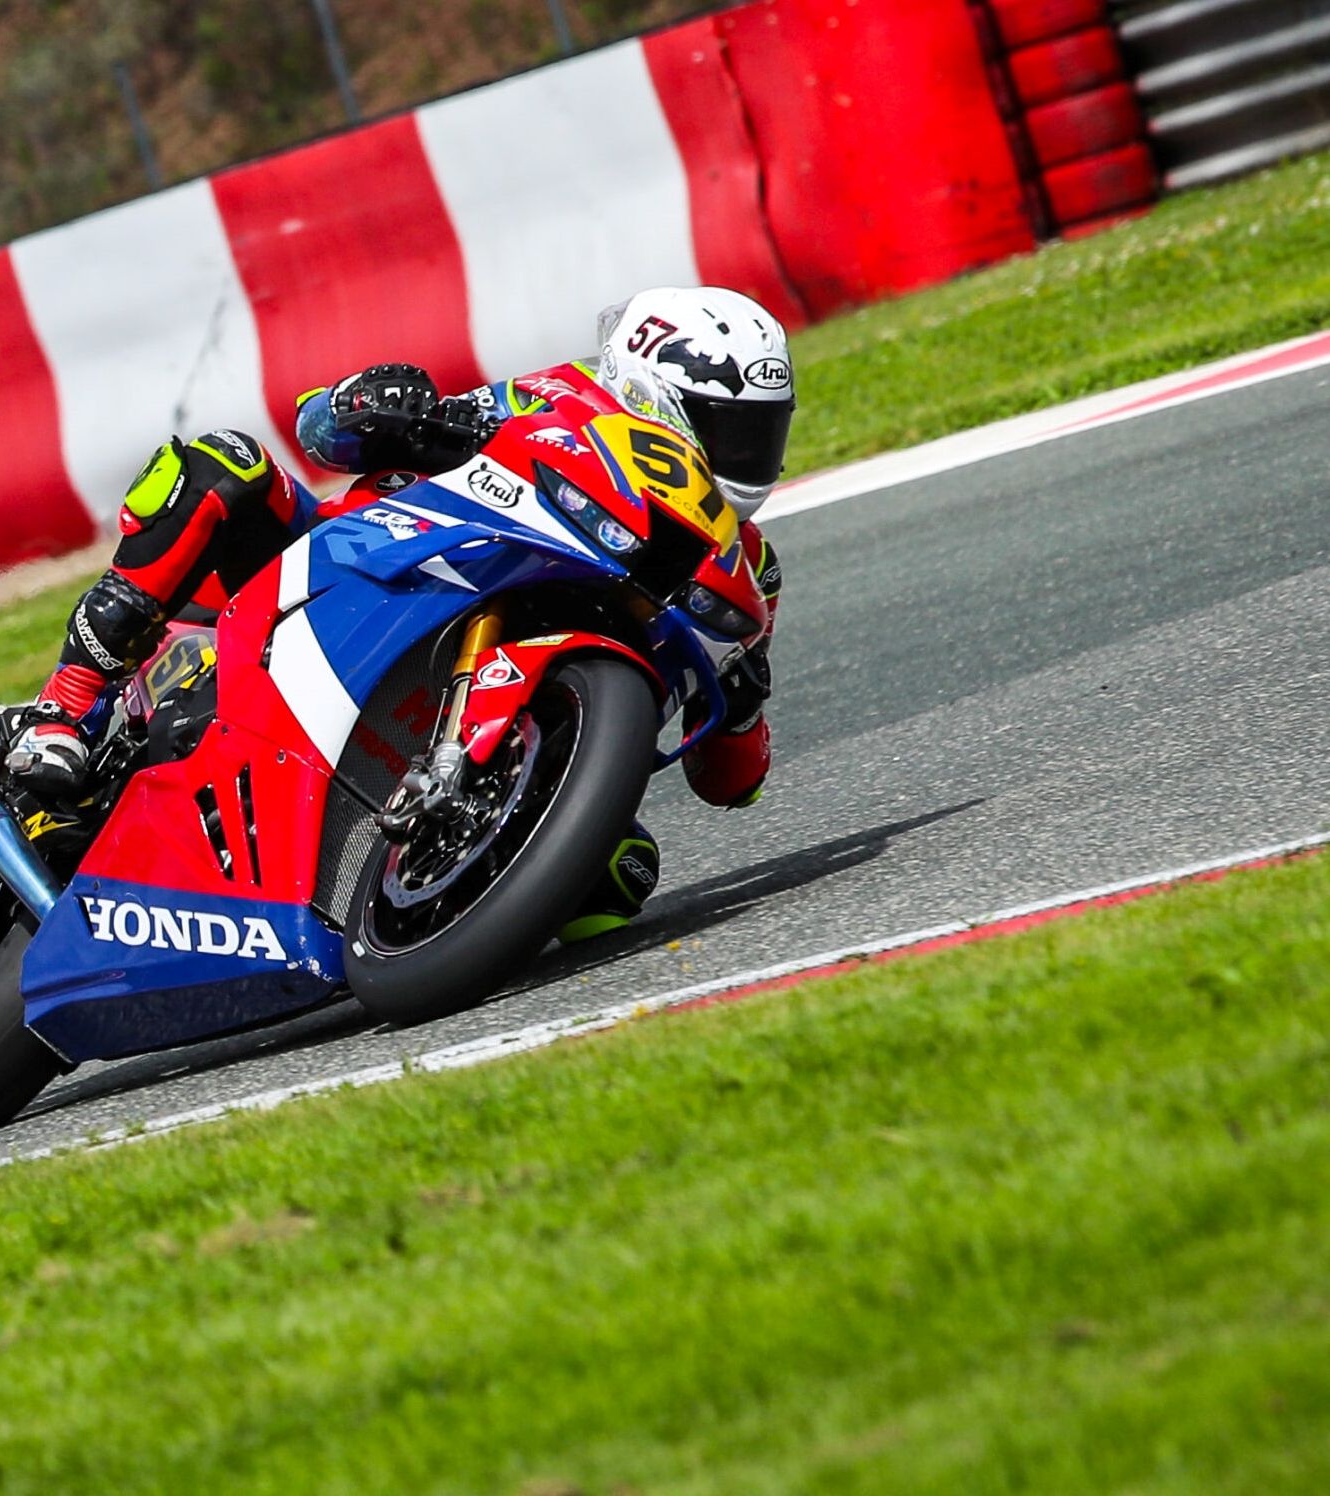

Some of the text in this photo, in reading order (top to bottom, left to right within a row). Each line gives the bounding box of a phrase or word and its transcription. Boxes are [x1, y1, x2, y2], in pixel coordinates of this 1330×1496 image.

[627, 315, 679, 360] 57
[747, 361, 788, 380] Arai
[469, 473, 513, 503] Arai
[83, 897, 288, 961] HONDA
